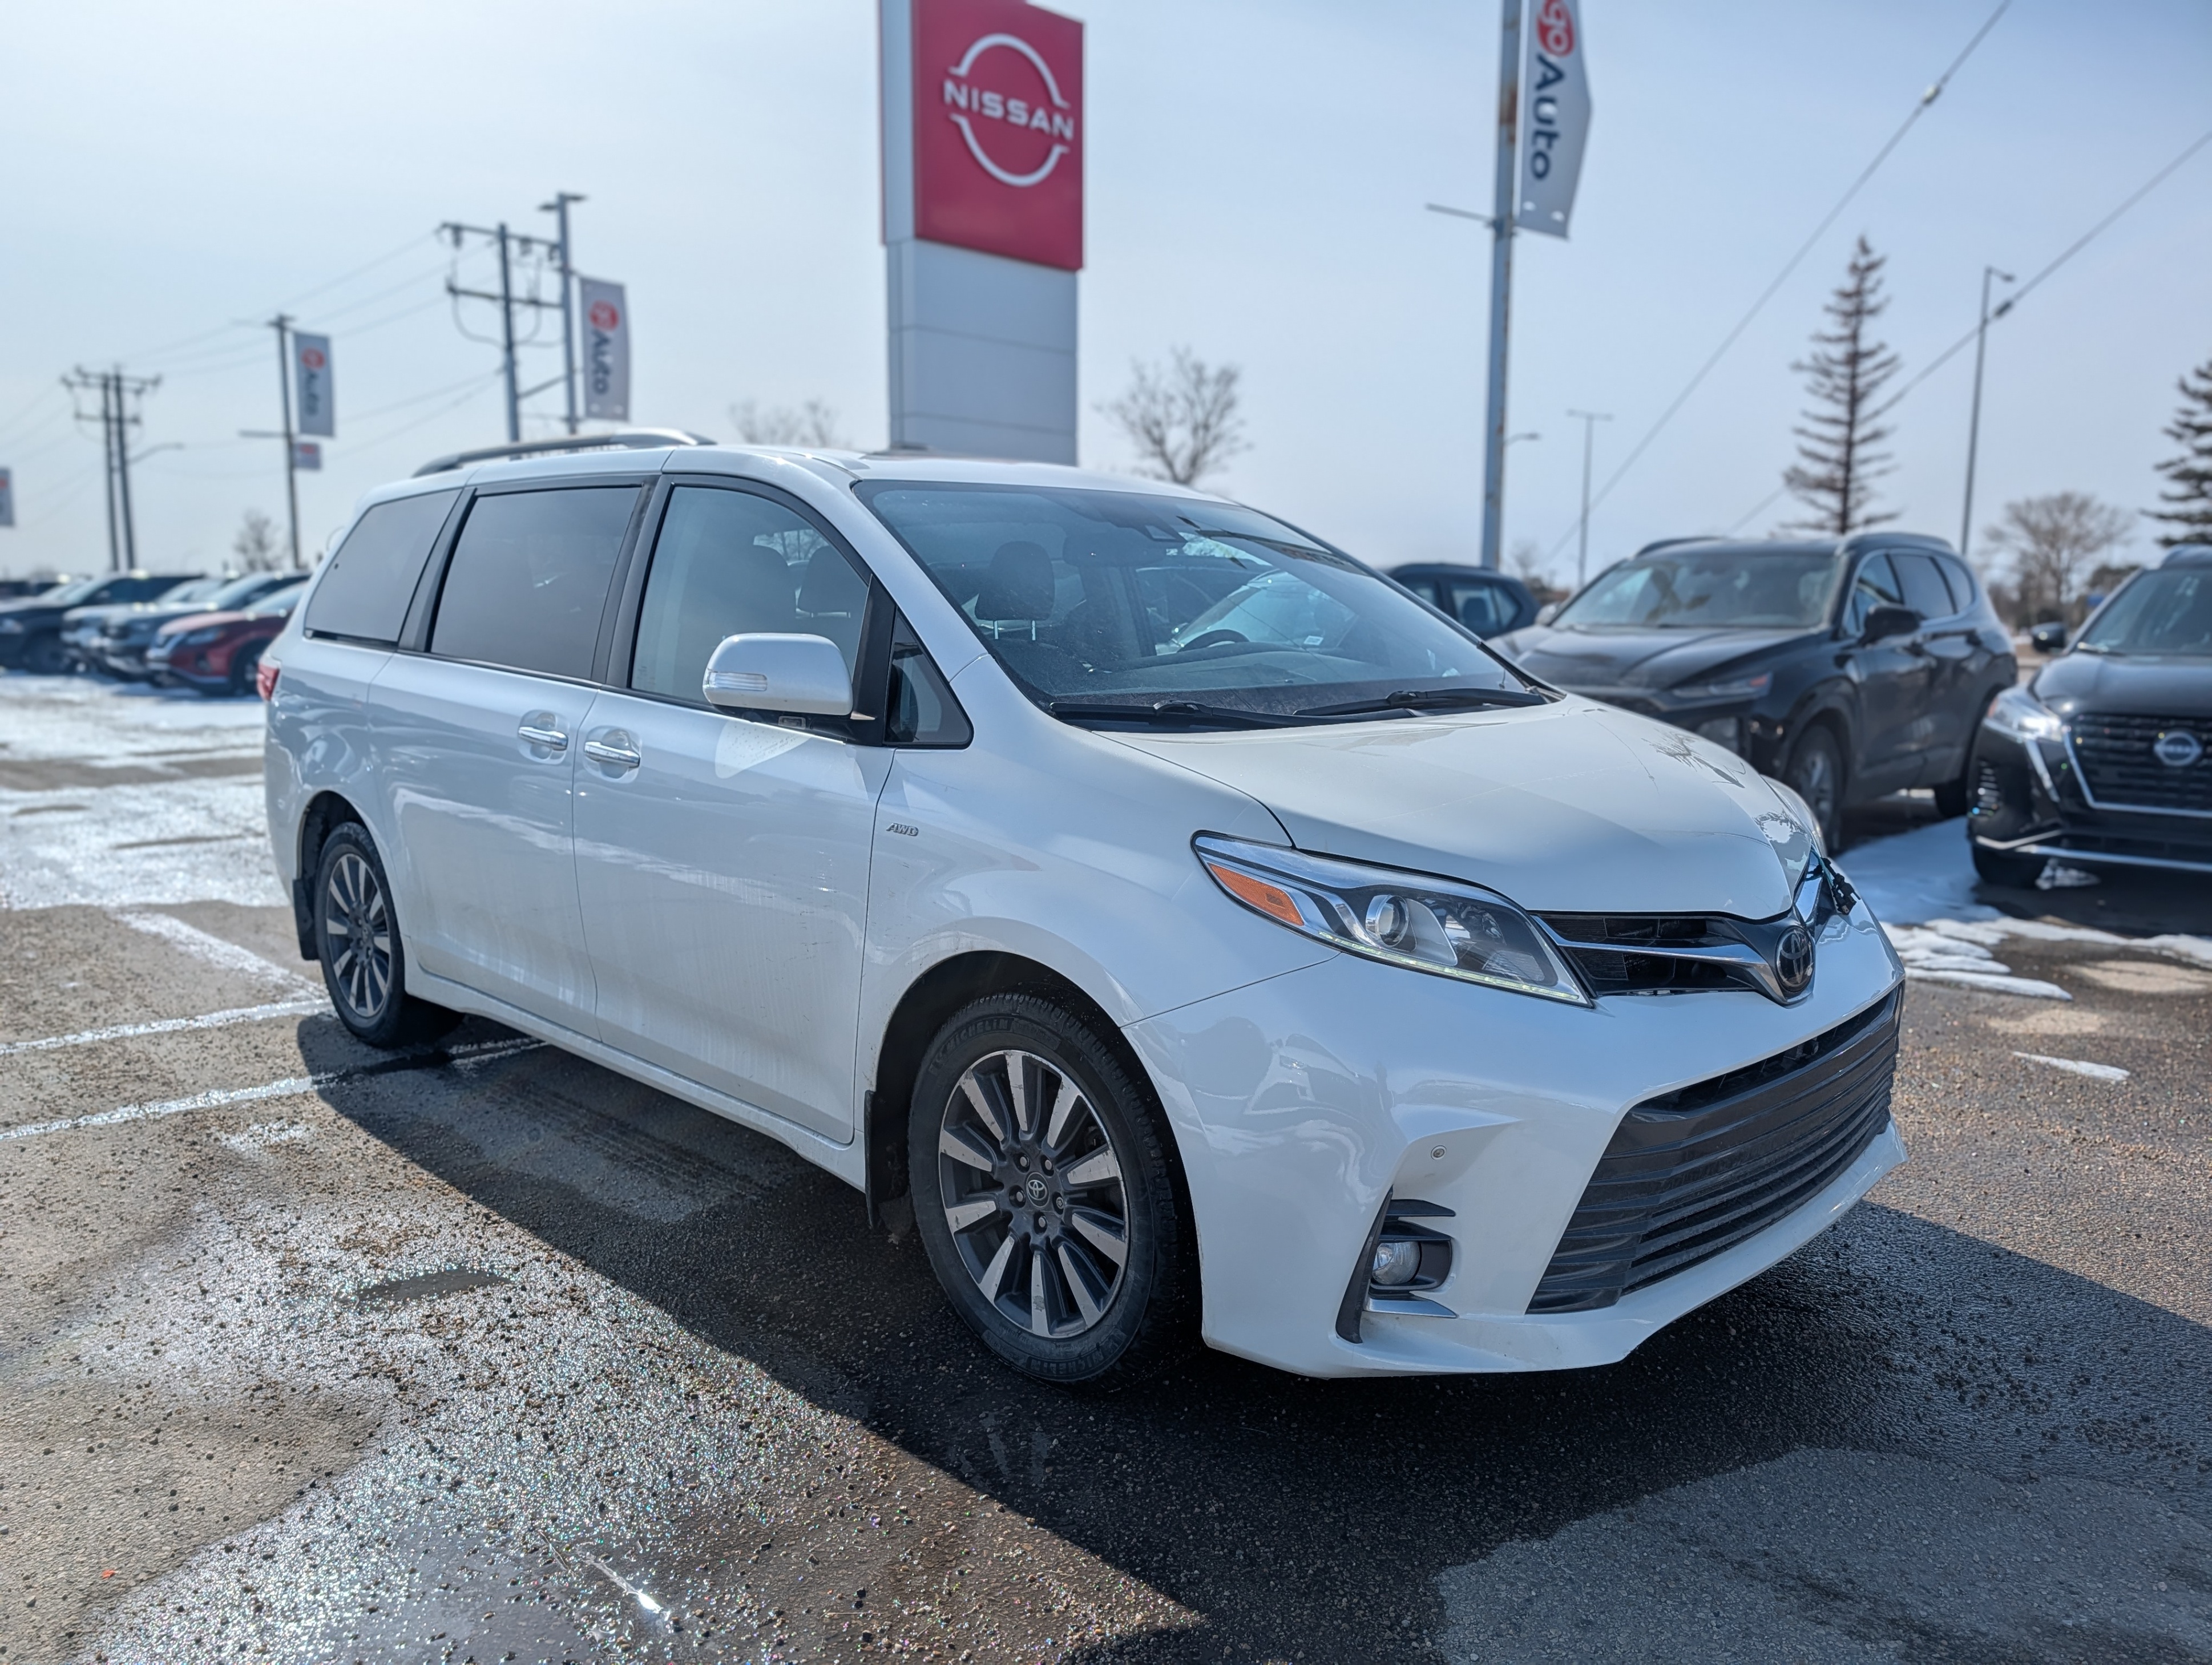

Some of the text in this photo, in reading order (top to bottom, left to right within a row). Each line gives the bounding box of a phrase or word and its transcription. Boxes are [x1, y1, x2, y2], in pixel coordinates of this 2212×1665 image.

[943, 79, 1074, 140] NISSAN
[1531, 54, 1565, 181] Auto
[886, 823, 919, 836] AWD
[946, 1017, 1010, 1052] MICHELIN
